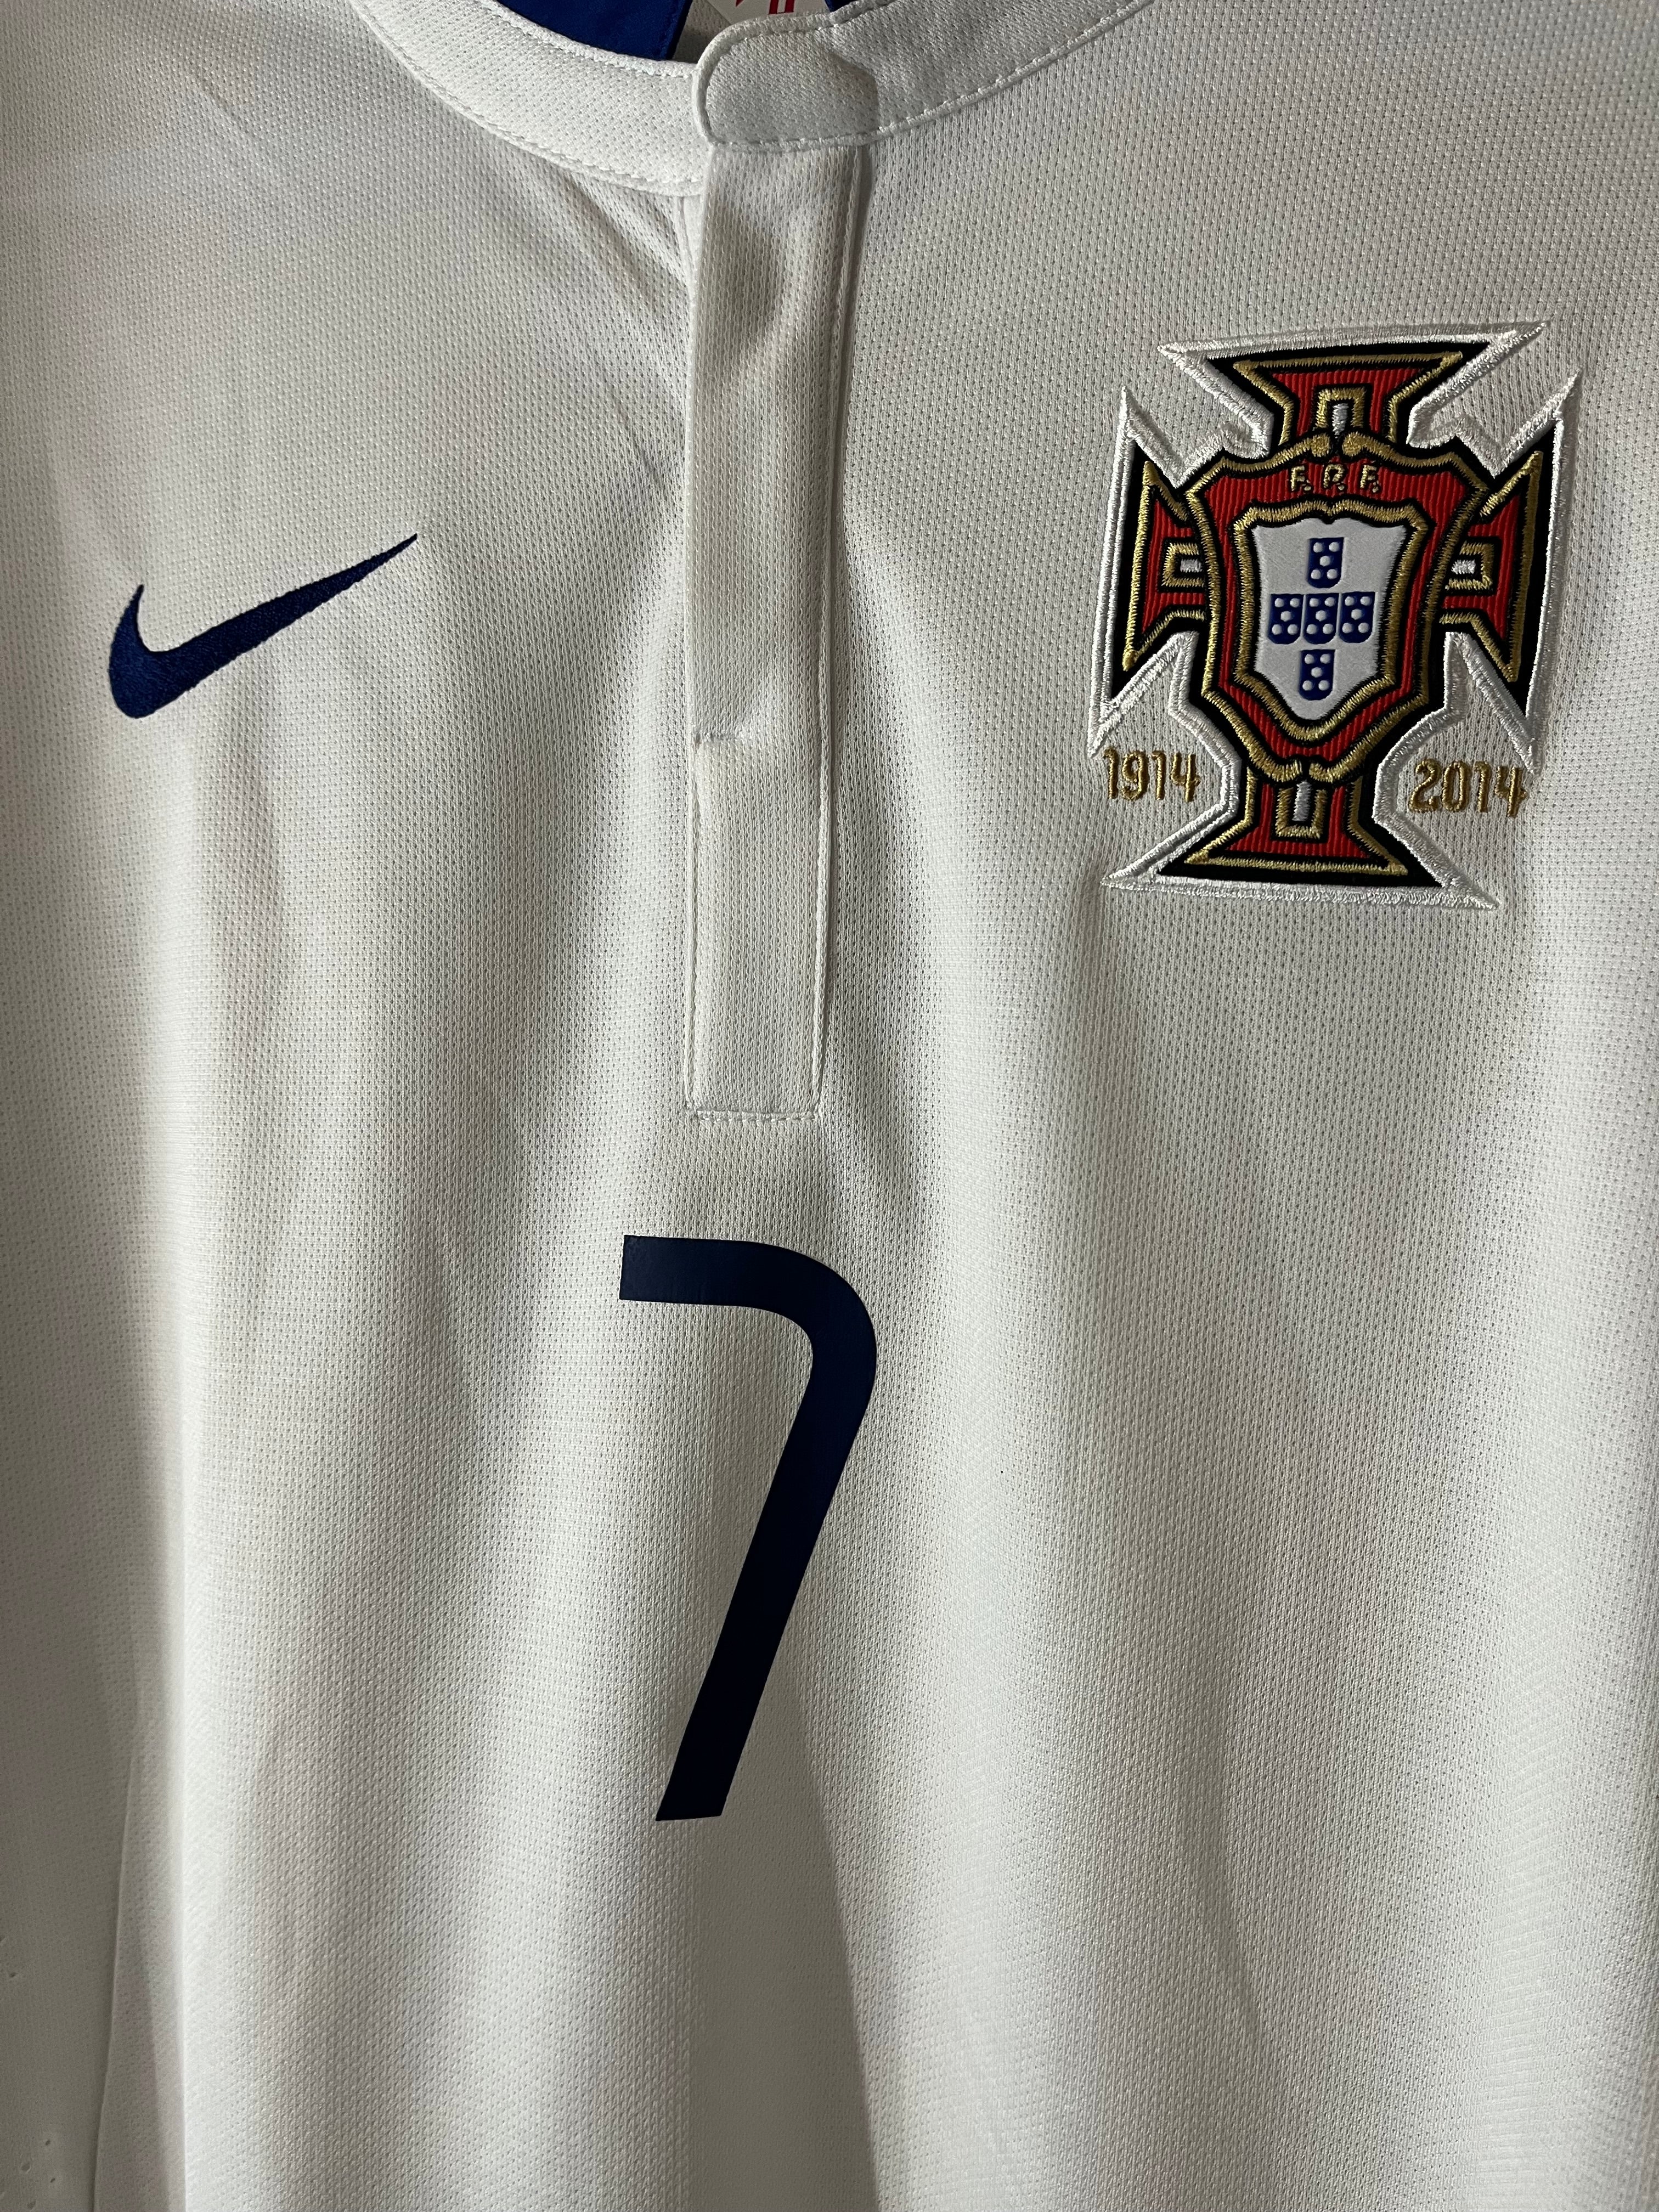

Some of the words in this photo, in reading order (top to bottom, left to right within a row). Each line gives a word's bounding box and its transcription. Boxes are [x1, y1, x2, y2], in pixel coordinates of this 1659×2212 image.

[1103, 747, 1200, 802] 1914
[1409, 758, 1528, 817] 2014
[619, 1234, 877, 1821] 7
